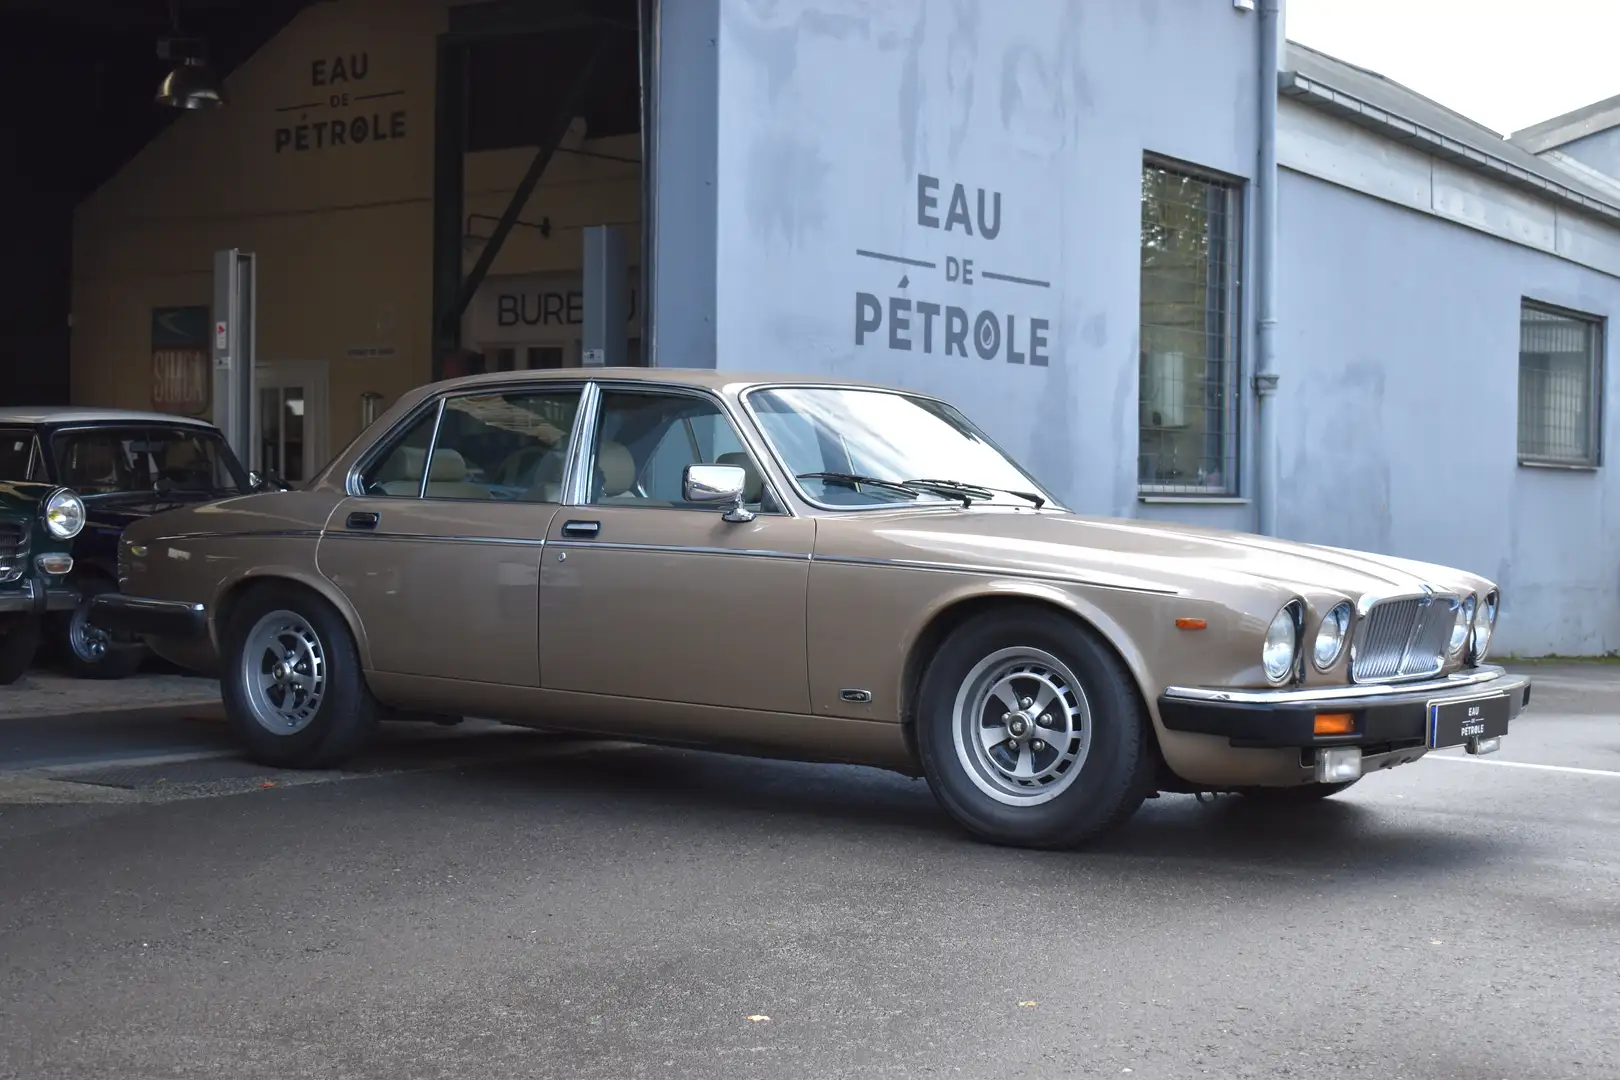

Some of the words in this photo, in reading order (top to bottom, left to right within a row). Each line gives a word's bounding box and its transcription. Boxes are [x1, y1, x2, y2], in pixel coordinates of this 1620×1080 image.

[312, 52, 368, 86] EAU
[330, 93, 350, 108] DE
[275, 113, 406, 153] PÉTROLE
[917, 173, 1002, 240] EAU
[945, 255, 974, 285] DE
[855, 275, 1050, 367] PÉTROLE
[1468, 706, 1480, 716] EAU
